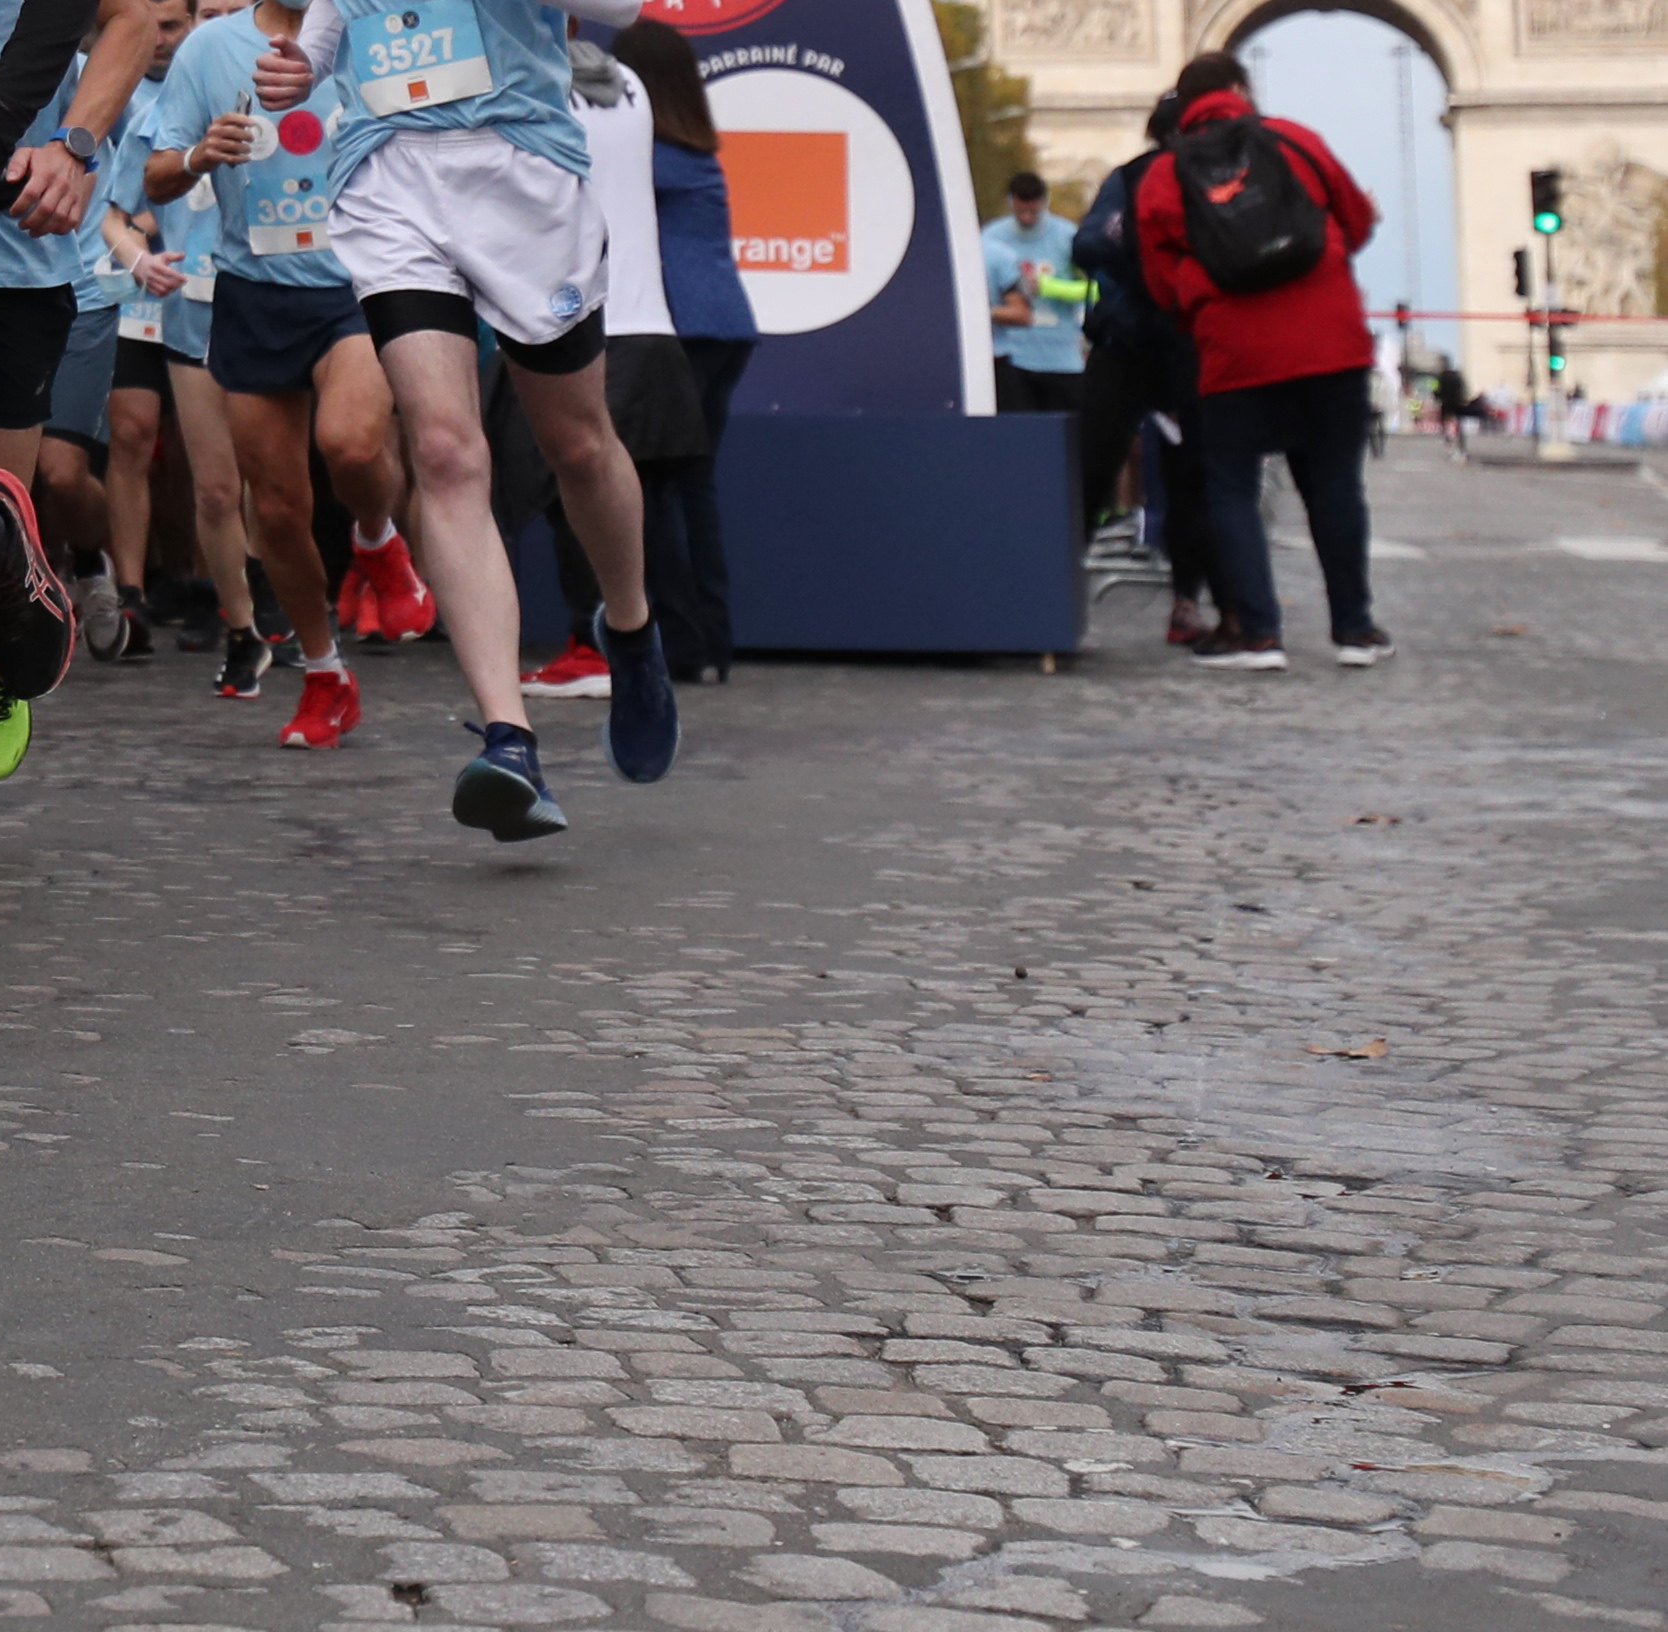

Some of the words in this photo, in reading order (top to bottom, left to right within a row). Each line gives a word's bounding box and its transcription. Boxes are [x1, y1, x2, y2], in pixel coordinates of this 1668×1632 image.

[368, 26, 454, 77] 3527
[697, 42, 799, 80] PARRAINÉ
[802, 48, 846, 78] PAR
[258, 195, 330, 223] 300
[732, 235, 835, 270] range
